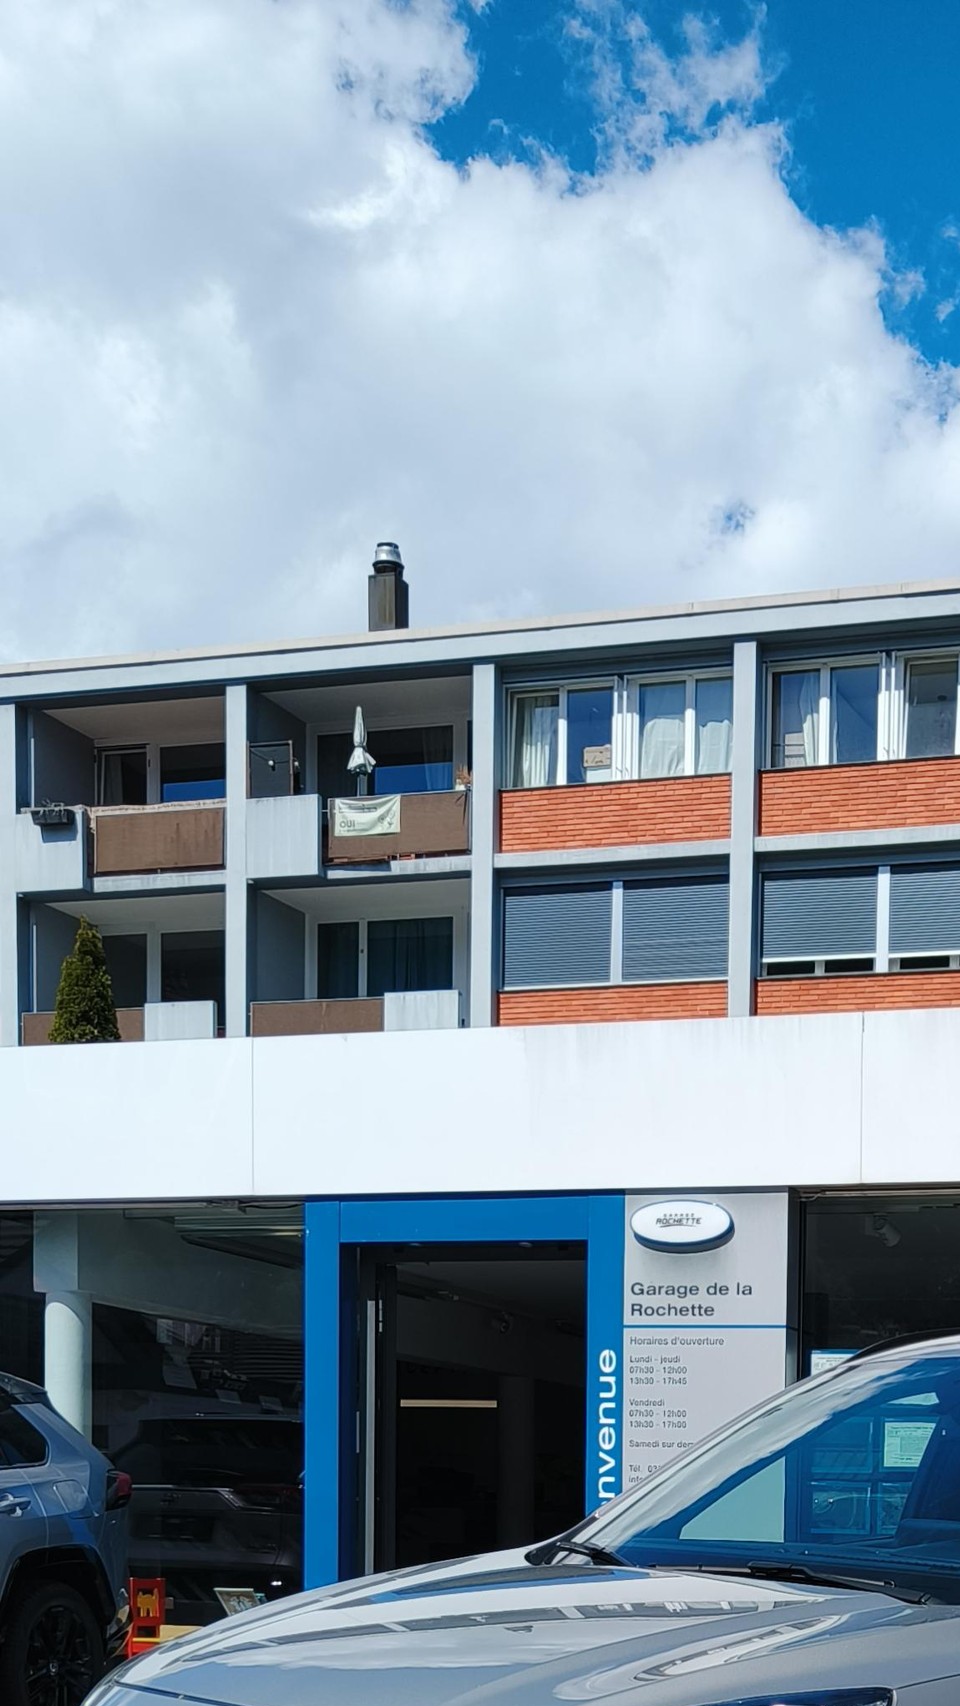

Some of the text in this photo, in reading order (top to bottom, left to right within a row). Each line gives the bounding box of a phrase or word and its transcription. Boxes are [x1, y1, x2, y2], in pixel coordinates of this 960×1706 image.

[656, 1217, 702, 1225] ROCHETTE
[630, 1281, 753, 1299] Garage de la
[630, 1303, 715, 1317] Rochette
[629, 1336, 725, 1346] Horaires d'ouverture
[629, 1355, 653, 1363] Lundi
[660, 1355, 681, 1364] jeudi
[629, 1366, 654, 1374] 07h30
[662, 1366, 687, 1374] 12h00
[629, 1377, 654, 1385] 13h30
[662, 1377, 687, 1385] 17h45
[629, 1399, 665, 1407] Vendredi
[629, 1409, 654, 1418] 07h30
[663, 1409, 687, 1418] 12h00
[598, 1349, 616, 1503] nvenue
[629, 1420, 654, 1429] 13h30
[662, 1420, 687, 1429] 17h00
[629, 1439, 660, 1448] Samedi
